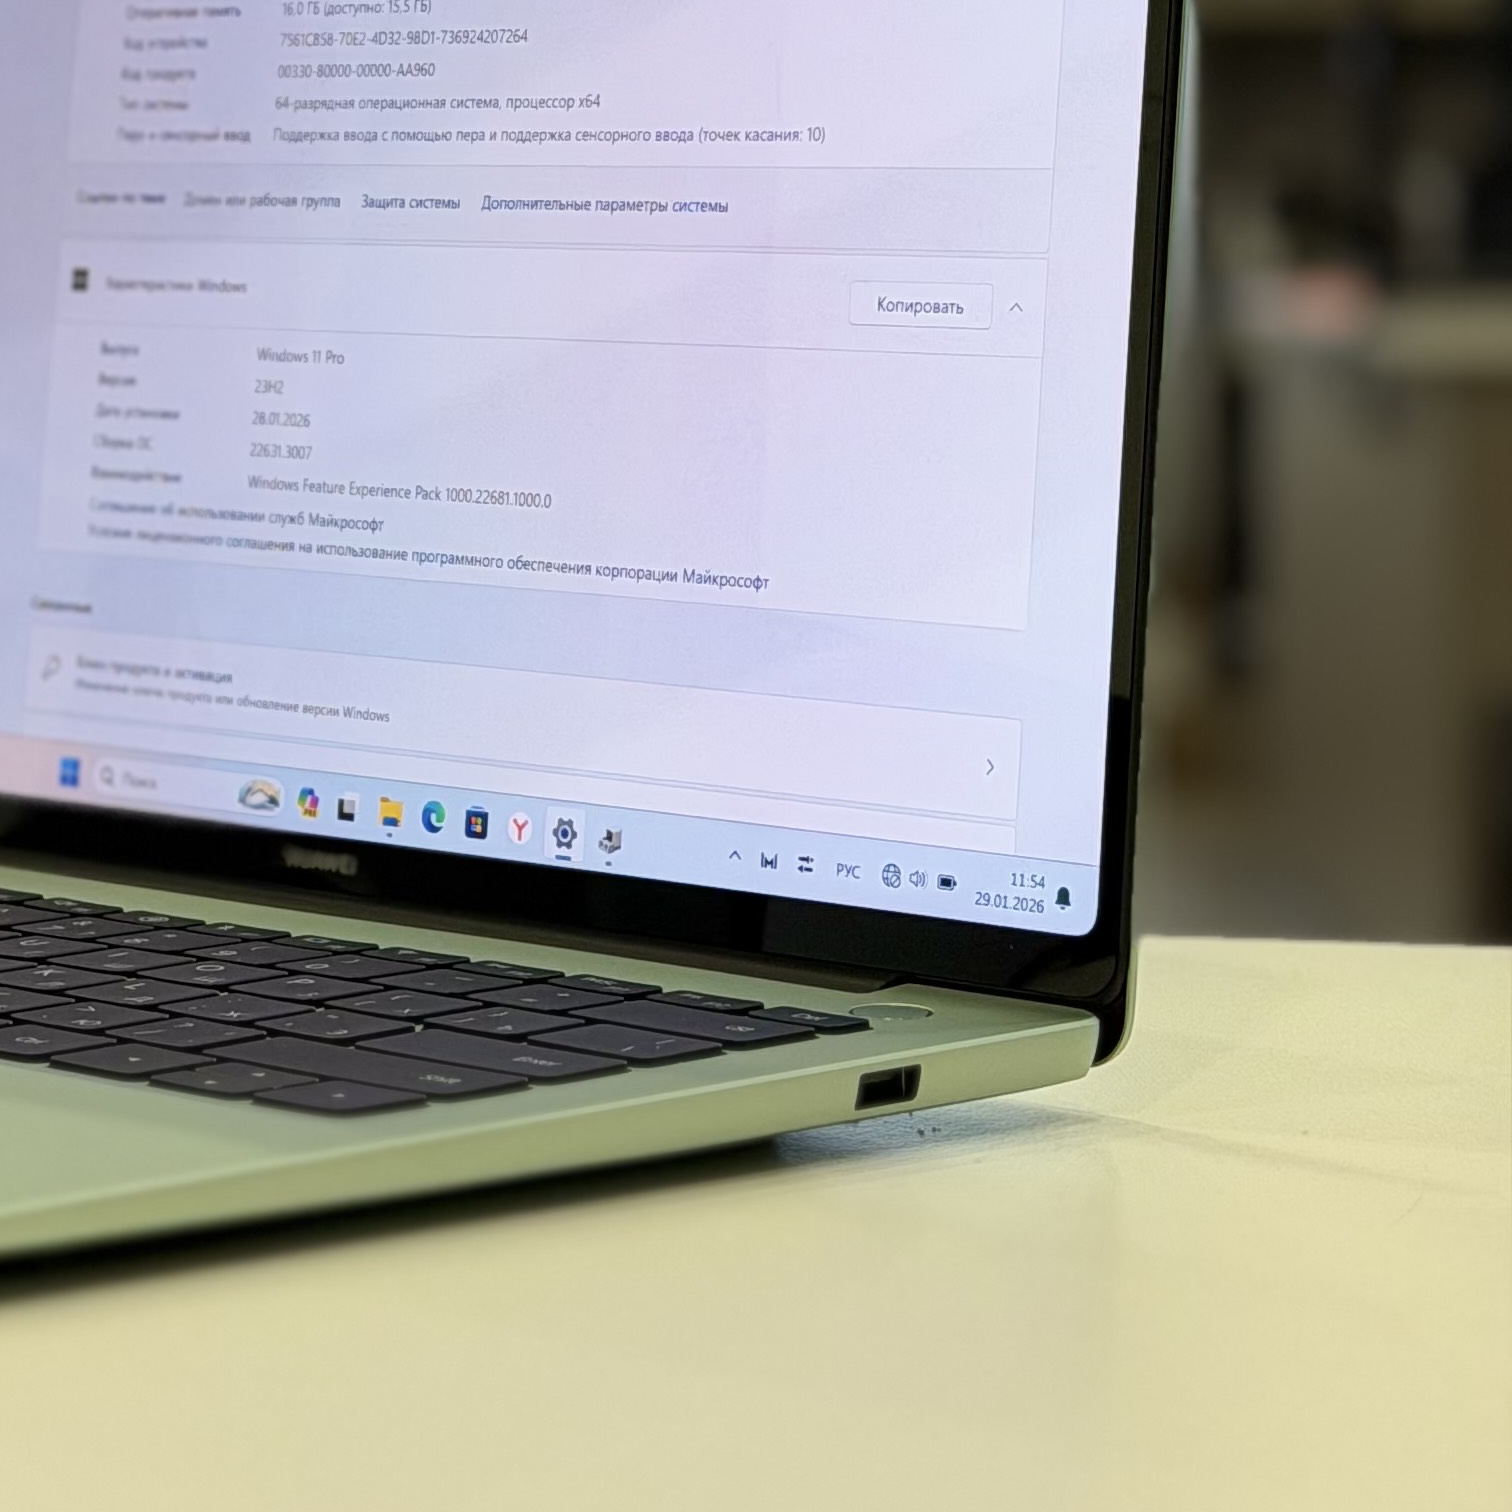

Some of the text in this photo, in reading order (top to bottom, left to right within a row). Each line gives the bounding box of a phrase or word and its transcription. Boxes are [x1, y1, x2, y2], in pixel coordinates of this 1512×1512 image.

[307, 1, 320, 15] ГБ
[324, 0, 385, 18] (доступно:
[278, 62, 435, 79] 00330-80000-00000-AA960
[275, 94, 601, 112] 64-разрядная операционная система, процессор x64
[273, 126, 826, 145] Поддержка ввода с помощью пера и поддержка сенсорного ввода (точек касания: 10)
[249, 193, 297, 209] рабочая
[301, 195, 341, 211] группа
[360, 194, 461, 211] Защита системы
[481, 195, 729, 216] Дополнительные параметры системы
[876, 295, 964, 318] Копировать
[257, 347, 345, 365] Windows 11 Pro
[254, 379, 284, 395] 23H2
[251, 411, 311, 428] 28.01.2026
[250, 443, 313, 460] 22631.3007
[248, 474, 552, 509] Windows Feature Experience Pack 1000.22681.1000.0
[268, 510, 305, 529] служб
[308, 512, 385, 535] Майкрософт
[226, 535, 295, 553] соглашения
[299, 543, 313, 555] на
[316, 544, 409, 562] использование
[411, 549, 504, 570] программного
[506, 554, 592, 576] обеспечения
[595, 563, 678, 584] корпорации
[682, 568, 770, 593] Майкрософт
[237, 694, 300, 714] обновление
[302, 703, 340, 719] версии
[343, 706, 391, 724] Windows
[836, 862, 862, 880] РУС
[1010, 872, 1046, 889] 11:54
[974, 891, 1045, 914] 29.01.2026
